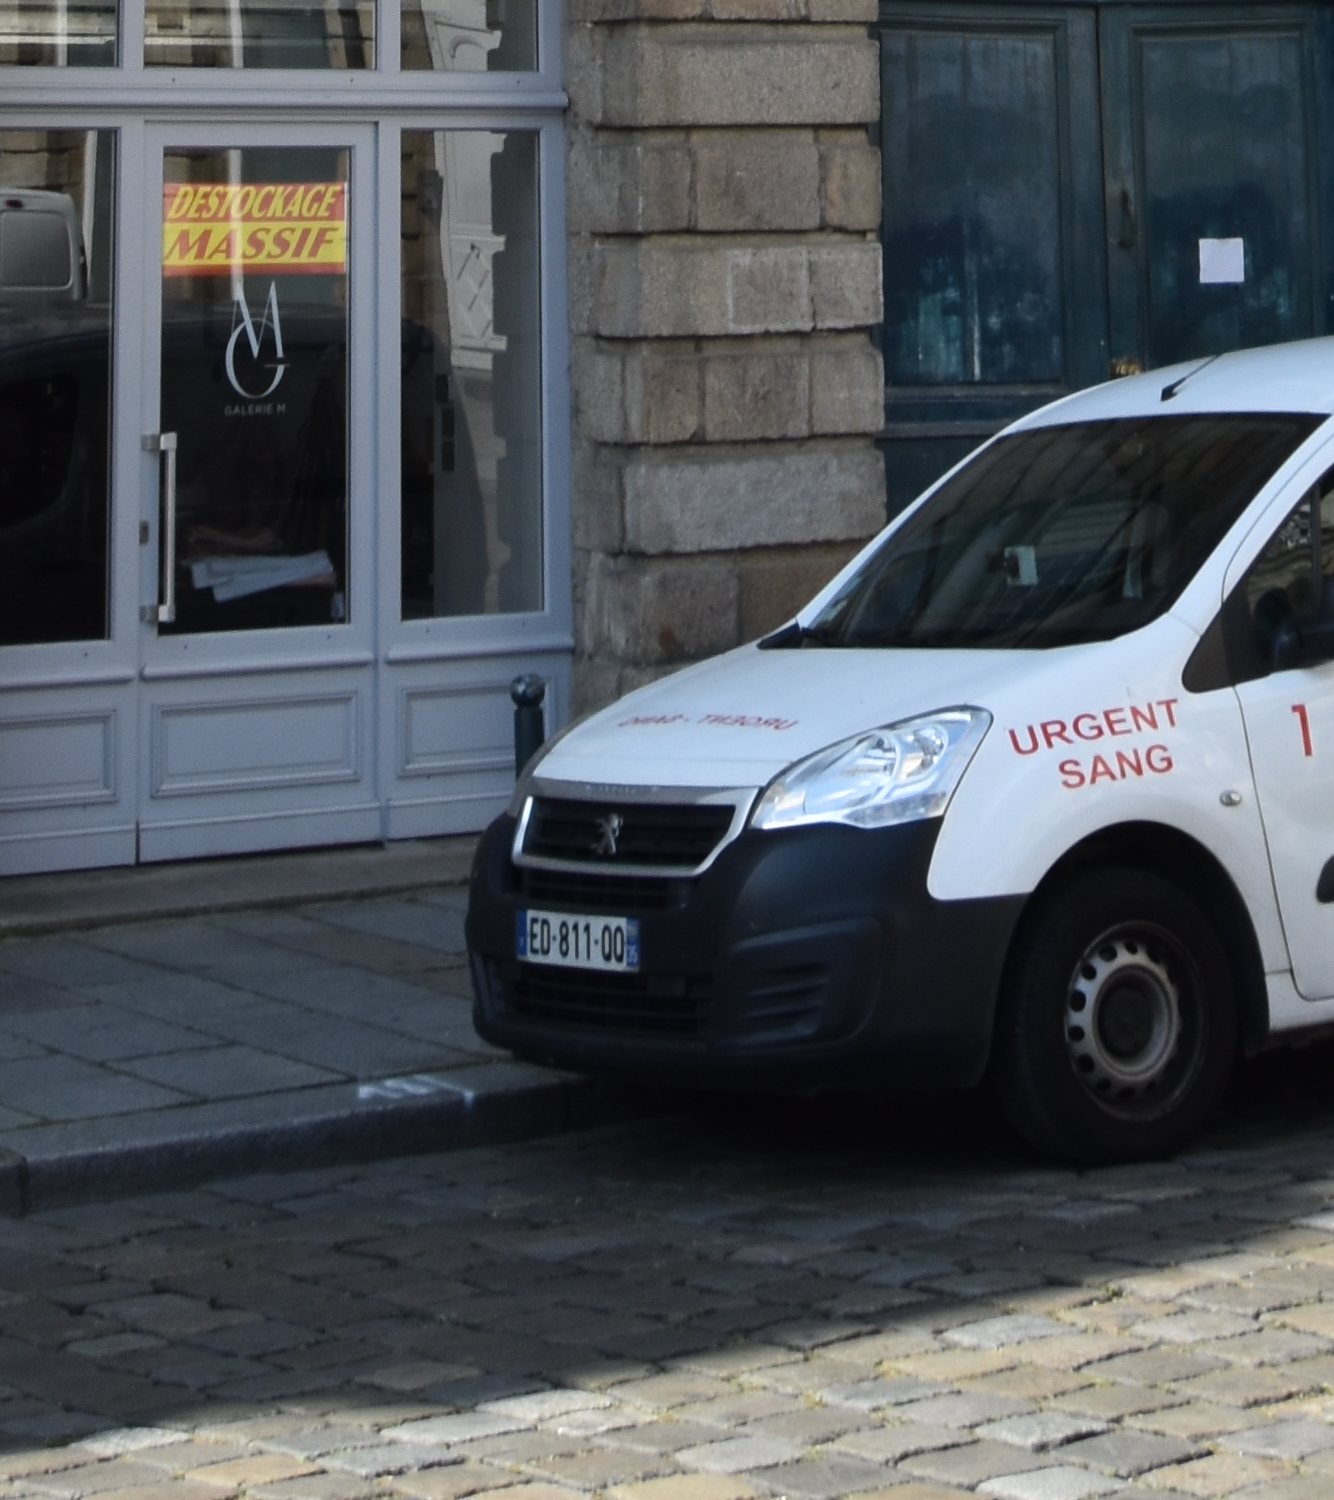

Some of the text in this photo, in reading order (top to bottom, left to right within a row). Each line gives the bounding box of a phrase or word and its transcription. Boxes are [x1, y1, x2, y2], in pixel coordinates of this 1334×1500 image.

[166, 185, 342, 219] DESTOCKAGE
[165, 227, 340, 260] MASSIF
[224, 403, 286, 416] GALERIE M
[1007, 698, 1179, 756] URGENT
[1291, 703, 1313, 757] 1
[1057, 743, 1174, 789] SANG
